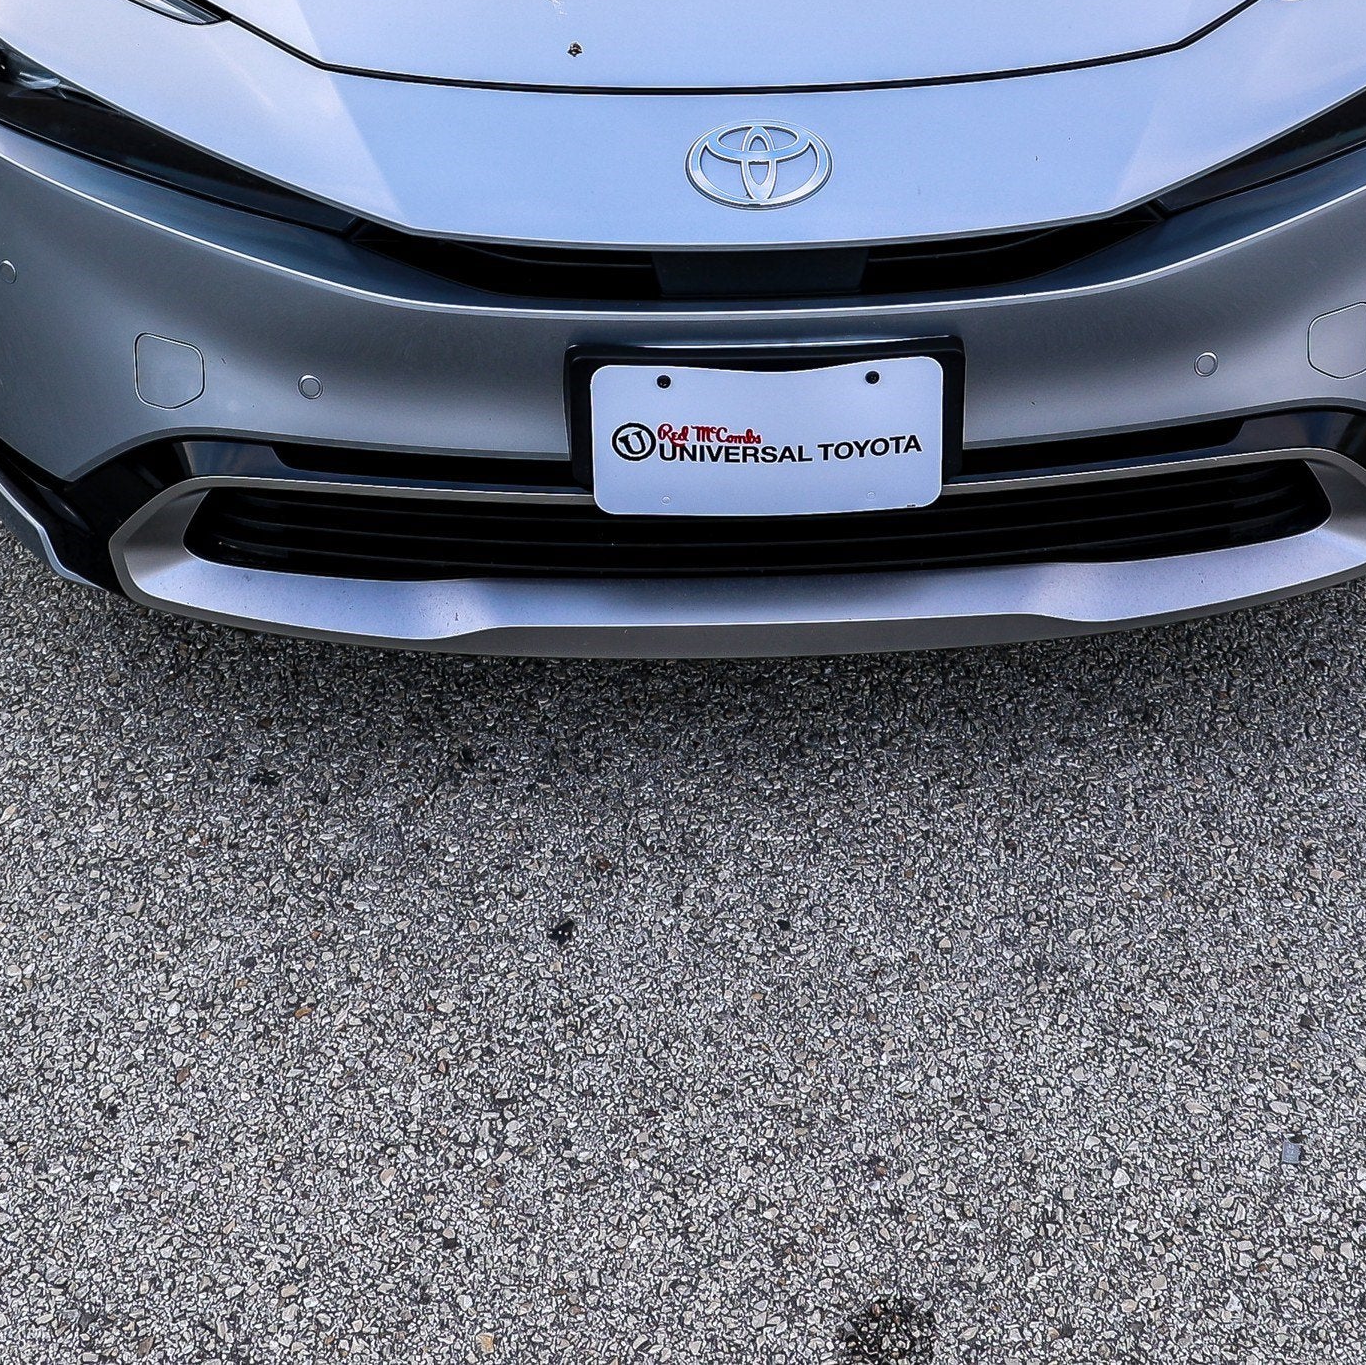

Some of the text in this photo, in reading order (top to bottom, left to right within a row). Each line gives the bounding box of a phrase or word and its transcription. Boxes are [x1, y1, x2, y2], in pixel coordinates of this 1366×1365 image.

[657, 423, 761, 447] Red McCombs
[659, 435, 922, 463] UNIVERSAL TOYOTA
